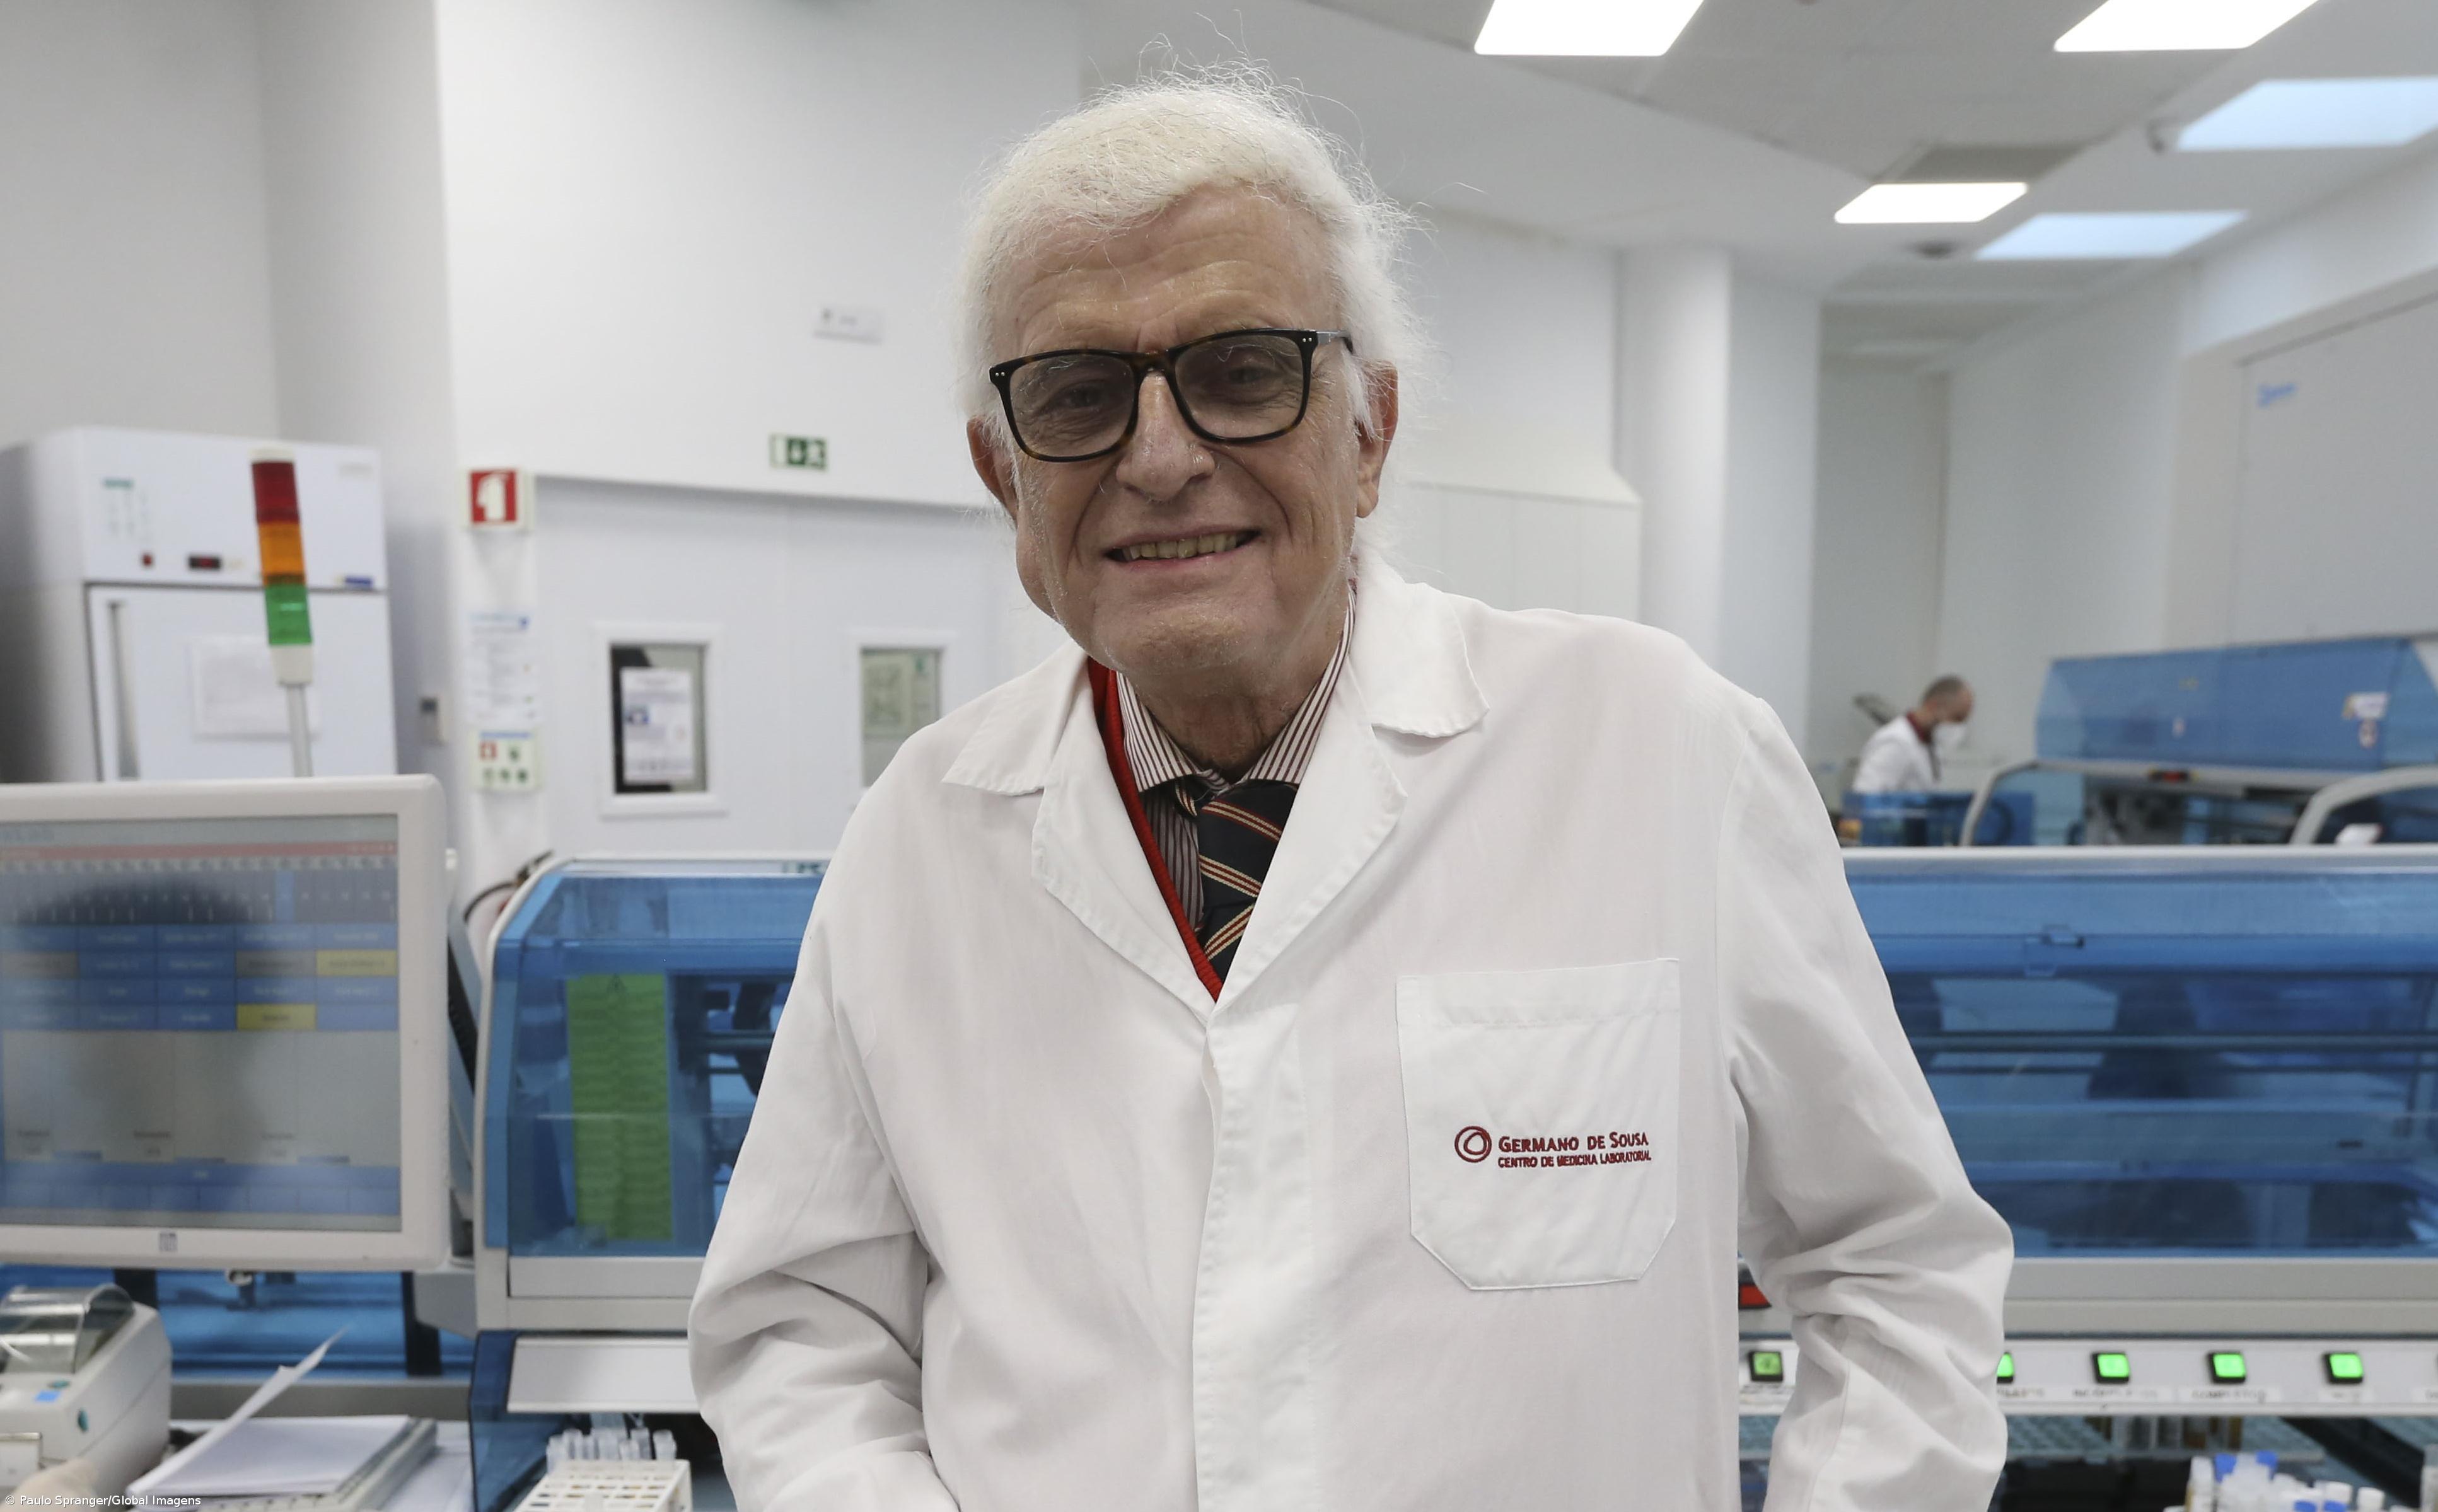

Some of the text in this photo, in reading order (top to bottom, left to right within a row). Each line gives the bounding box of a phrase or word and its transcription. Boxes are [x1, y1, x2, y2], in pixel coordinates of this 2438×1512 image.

[1498, 1131, 1649, 1153] GERMANO DE SOUSA
[1497, 1150, 1652, 1168] CENTRO DE MEDICINA LABORATORIAL
